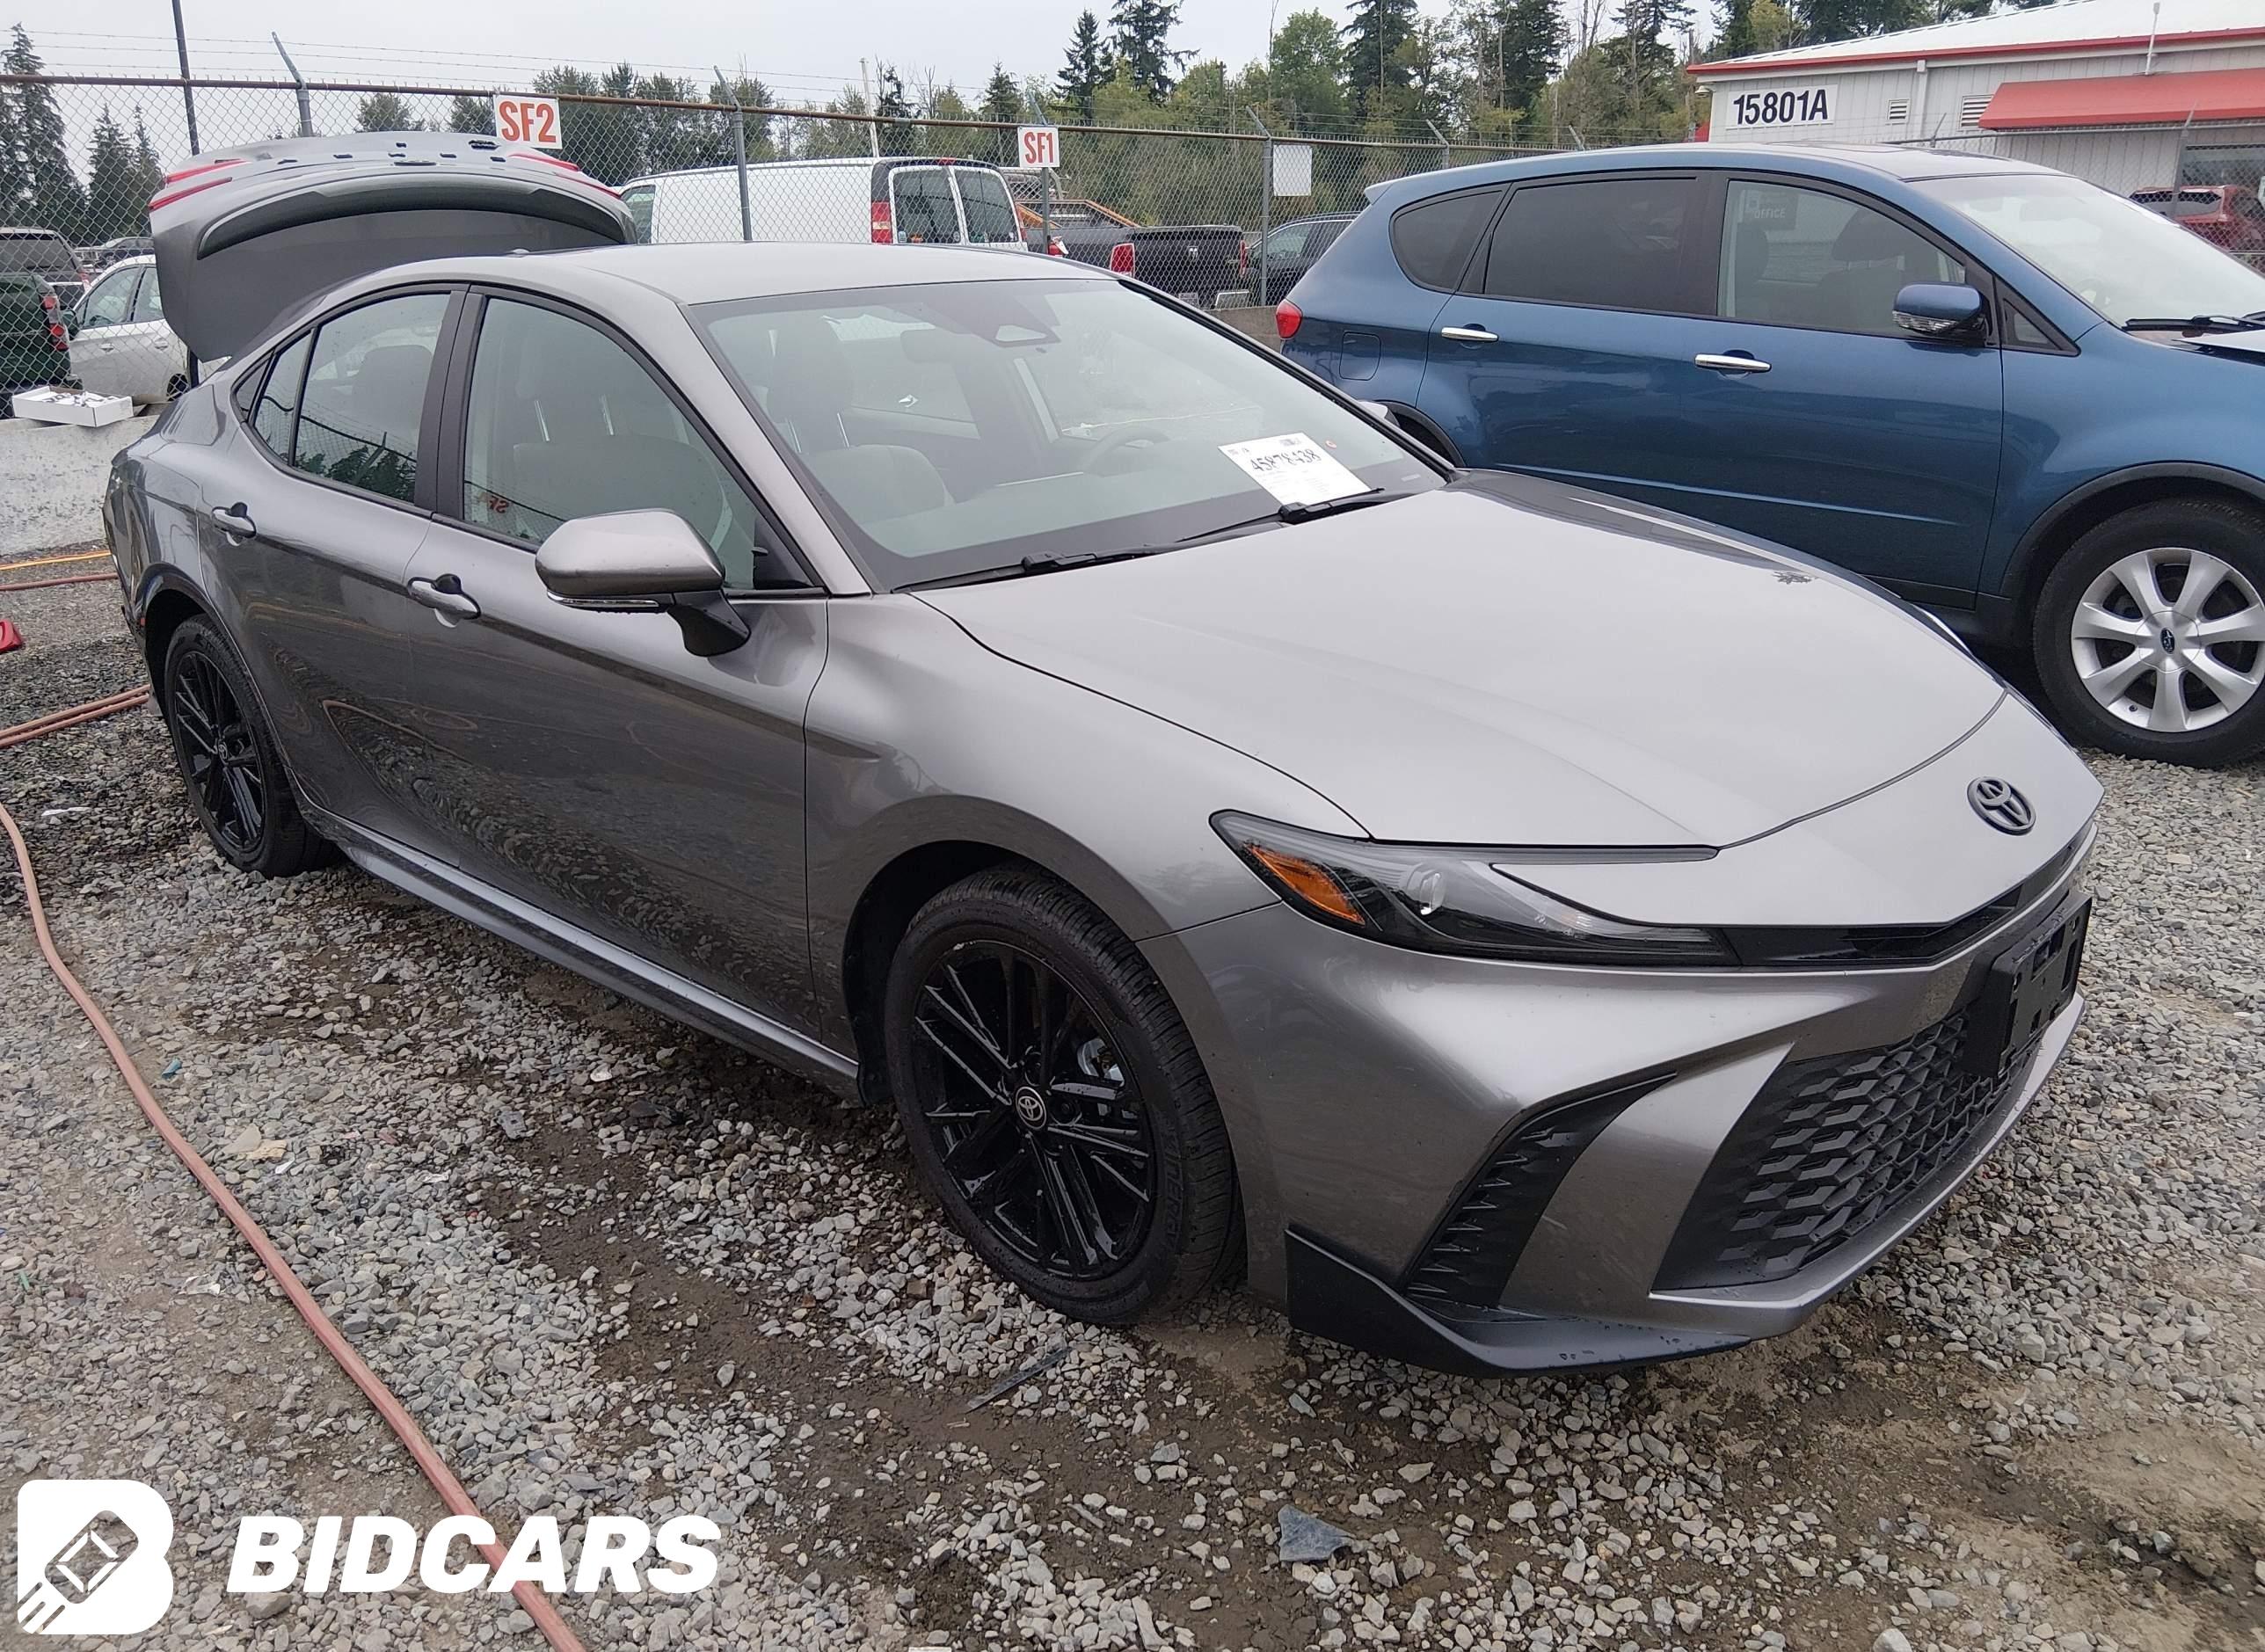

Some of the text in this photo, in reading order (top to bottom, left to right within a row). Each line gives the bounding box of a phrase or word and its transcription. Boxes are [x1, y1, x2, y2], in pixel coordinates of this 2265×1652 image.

[499, 100, 557, 143] SF2
[1733, 89, 1828, 125] 15801A
[1023, 131, 1054, 164] SF1
